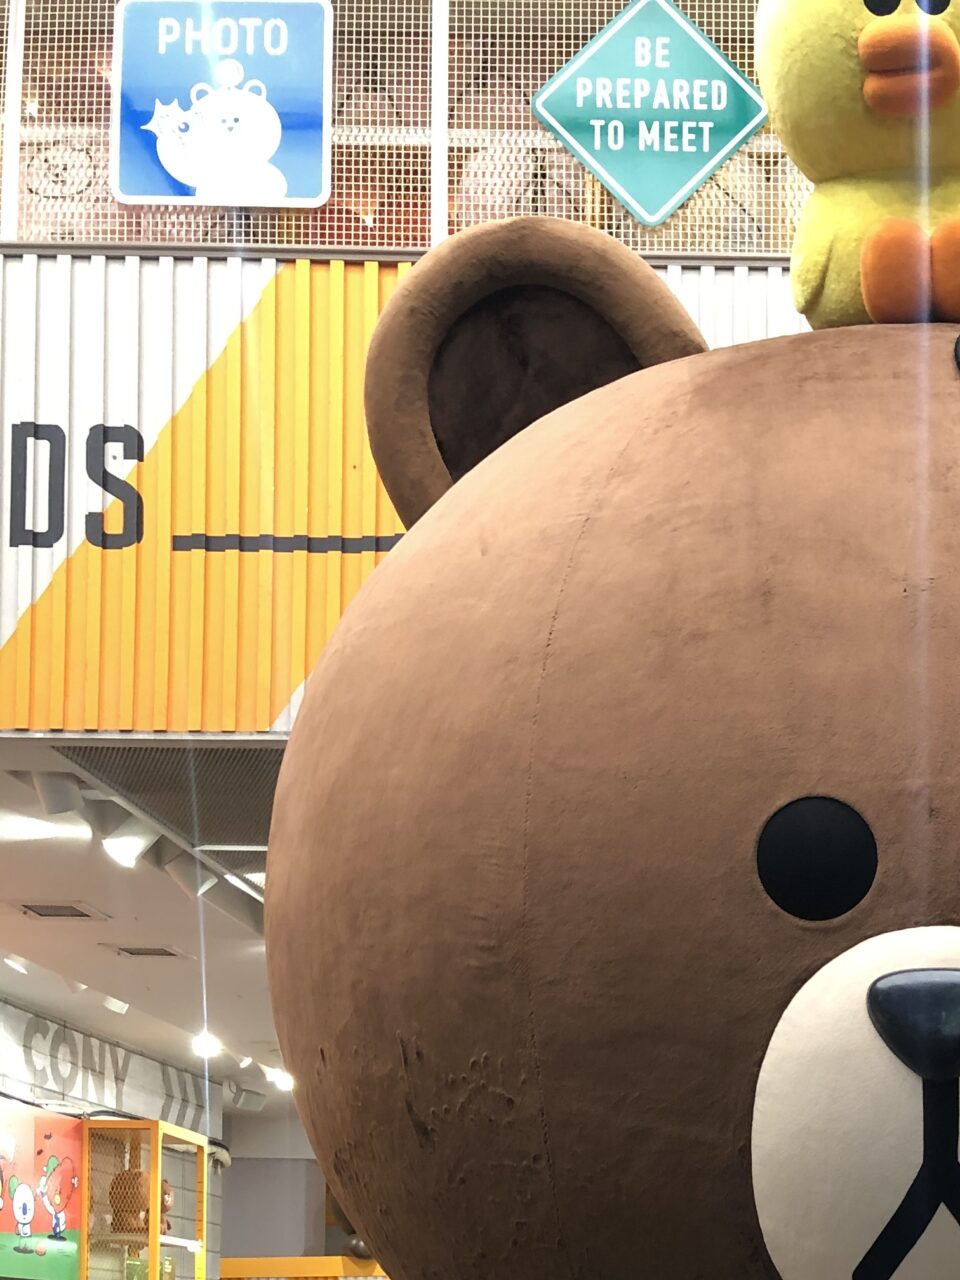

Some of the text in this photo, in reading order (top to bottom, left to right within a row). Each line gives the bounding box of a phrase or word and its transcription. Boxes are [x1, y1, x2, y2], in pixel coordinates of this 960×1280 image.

[158, 17, 288, 56] PHOTO
[634, 36, 671, 68] BE
[575, 76, 728, 111] PREPARED
[589, 119, 715, 153] TO MEET
[9, 421, 145, 550] DS
[23, 1015, 132, 1111] CONY
